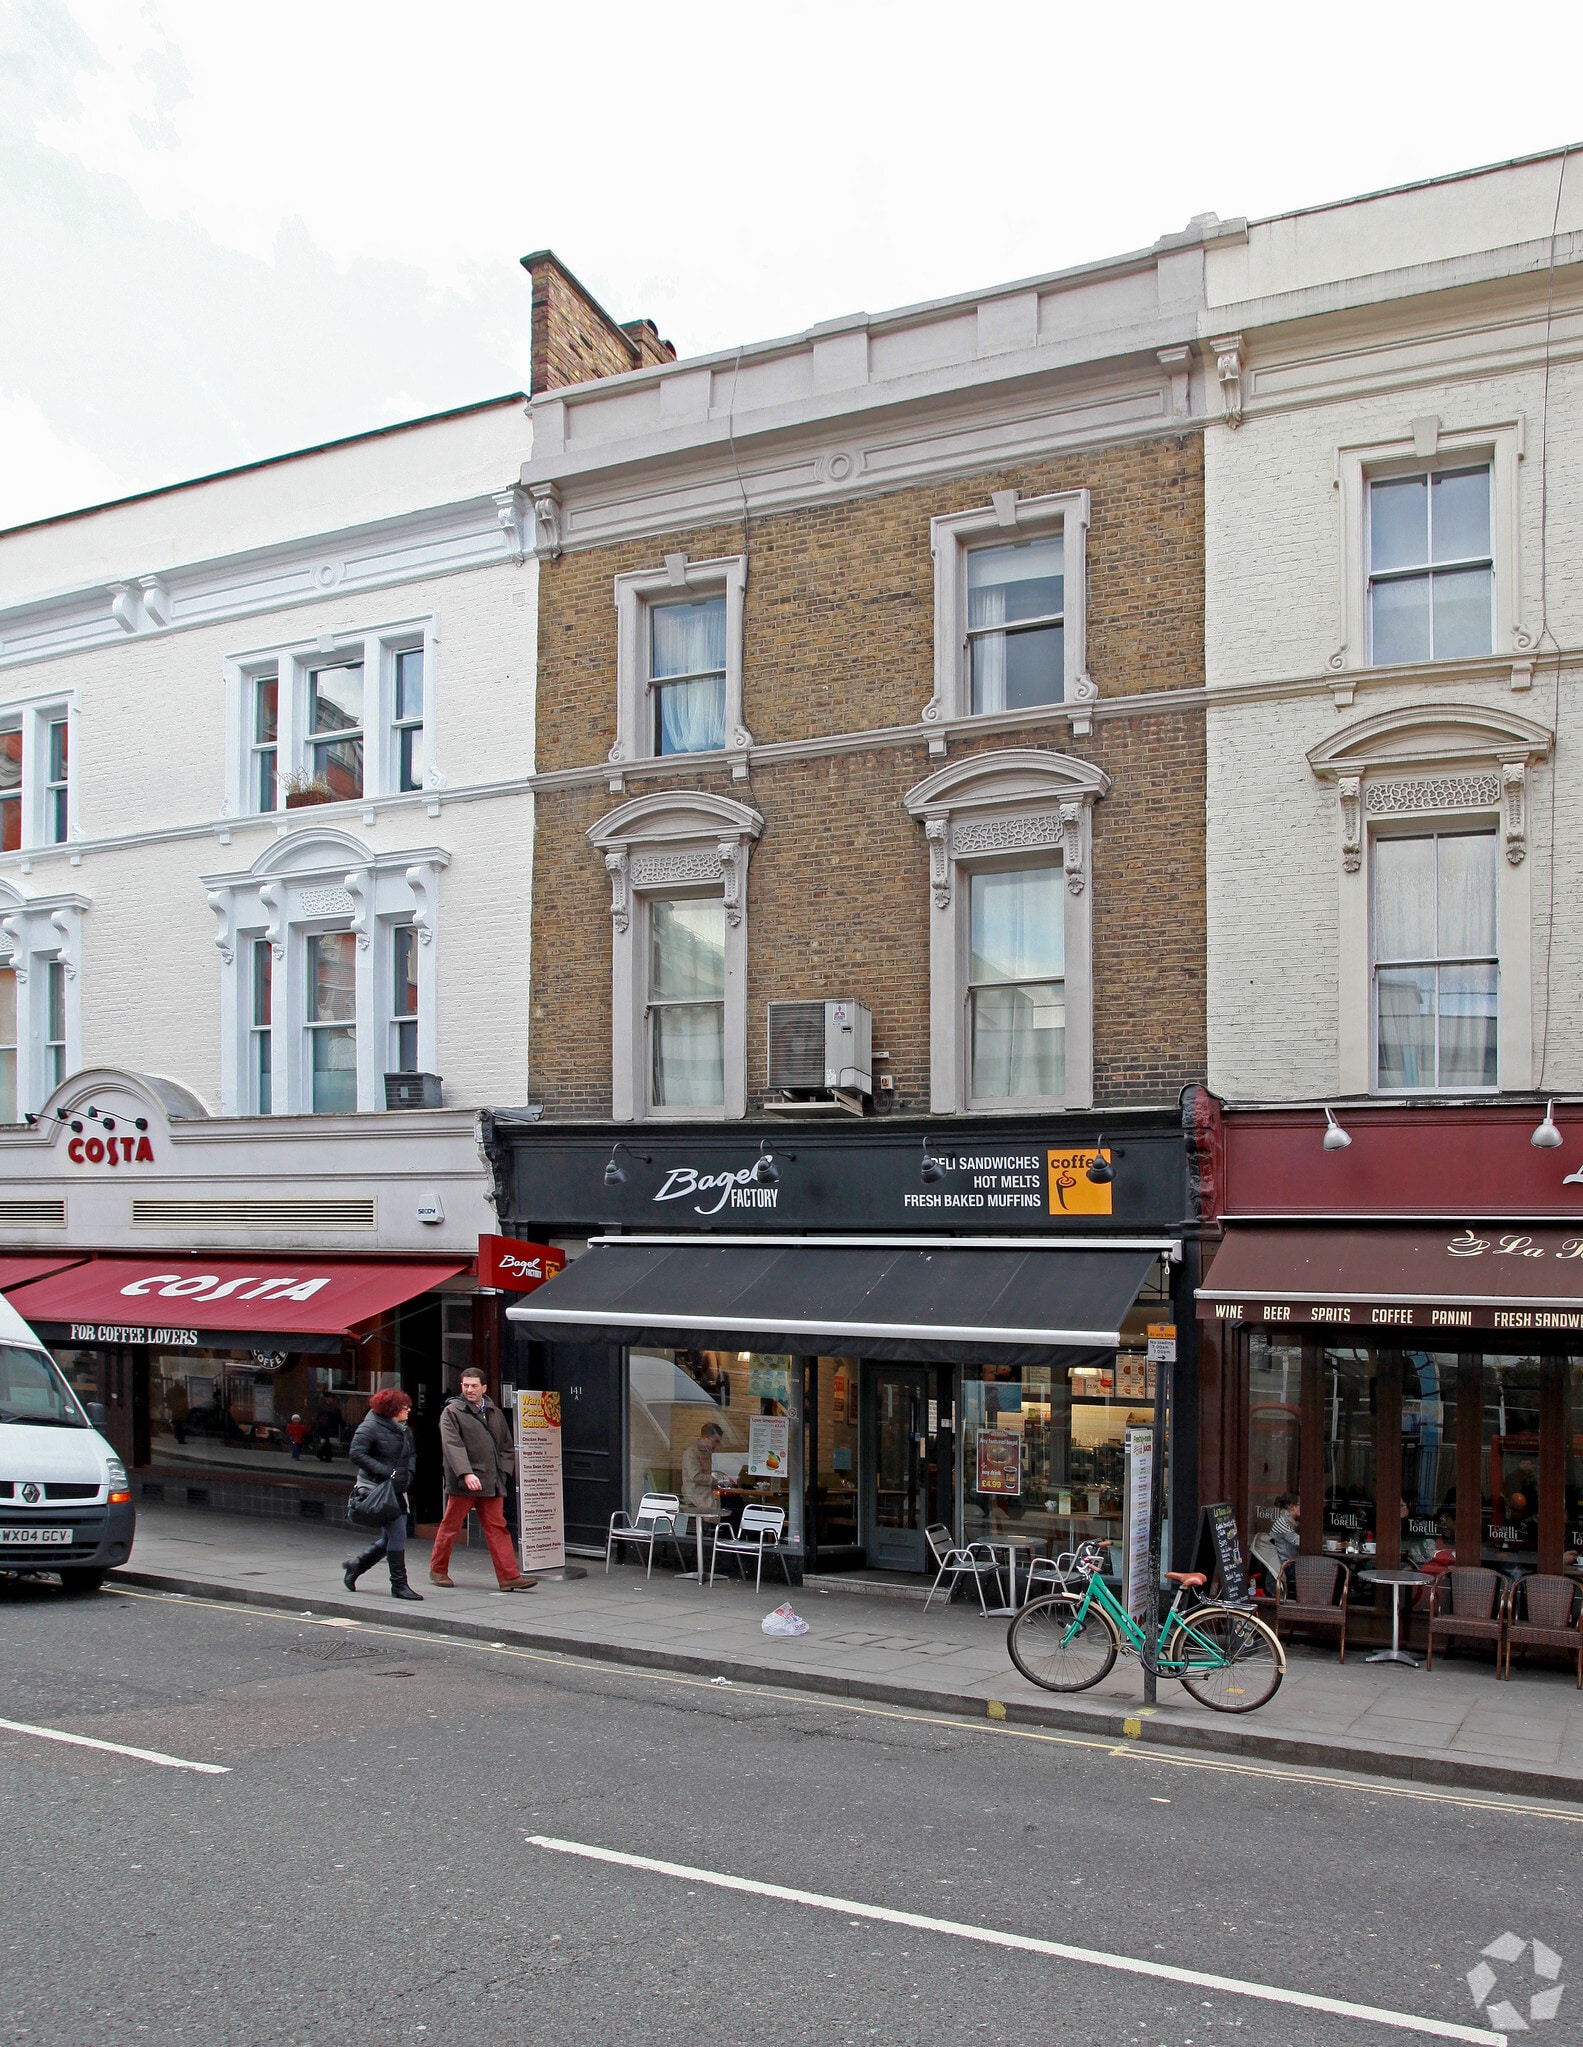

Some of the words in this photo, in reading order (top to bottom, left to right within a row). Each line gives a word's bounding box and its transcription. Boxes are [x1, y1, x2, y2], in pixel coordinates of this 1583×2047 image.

[68, 1136, 155, 1166] COSTA
[959, 1156, 1040, 1170] SANDWICHES
[1050, 1154, 1093, 1169] coffe
[973, 1175, 998, 1188] HOT
[1001, 1175, 1040, 1188] MELTS
[731, 1188, 778, 1208] FACTORY
[904, 1194, 942, 1207] FRESH
[944, 1194, 984, 1207] BAKED
[987, 1194, 1041, 1207] MUFFINS
[1492, 1235, 1545, 1258] La
[498, 1254, 542, 1278] Bagel
[525, 1268, 542, 1279] FACTORY
[120, 1275, 331, 1302] COSTA
[1215, 1304, 1244, 1319] WINE
[1263, 1306, 1291, 1320] BEER
[1311, 1307, 1351, 1322] SPRITS
[1371, 1308, 1413, 1324] COFFEE
[1431, 1310, 1472, 1326] PANINI
[1494, 1311, 1532, 1327] FRESH
[71, 1324, 96, 1341] FOR
[98, 1326, 145, 1344] COFFEE
[146, 1328, 198, 1346] LOVERS
[570, 1386, 582, 1395] 141
[522, 1395, 545, 1406] Warm
[522, 1406, 545, 1417] Pasta
[522, 1417, 549, 1429] Salads
[981, 1479, 1002, 1488] £4.99
[2, 1530, 38, 1542] WX04
[42, 1530, 68, 1542] GCV
